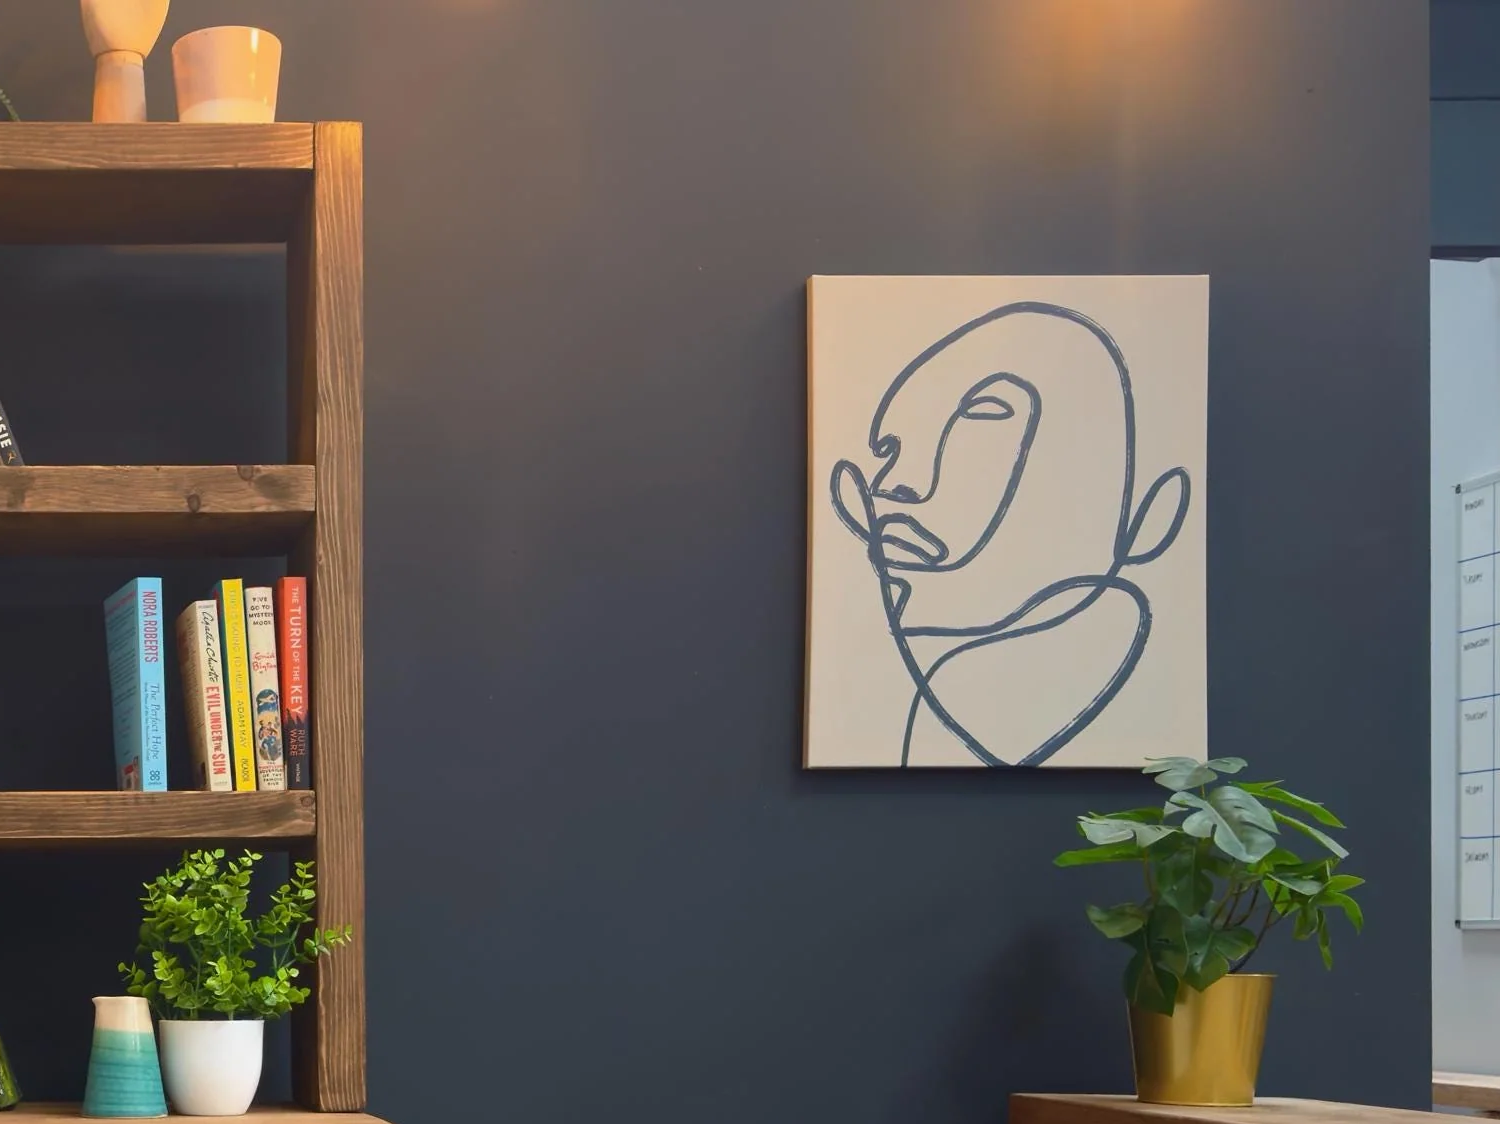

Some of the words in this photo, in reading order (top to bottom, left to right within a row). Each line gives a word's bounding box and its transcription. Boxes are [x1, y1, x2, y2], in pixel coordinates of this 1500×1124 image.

[142, 591, 158, 618] NORA
[291, 586, 300, 604] THE
[289, 606, 303, 648] TURN
[143, 620, 159, 663] ROBERTS
[292, 651, 301, 662] OF
[292, 666, 301, 681] THE
[150, 683, 160, 701] The
[205, 686, 221, 711] EVIL
[290, 685, 304, 714] KEY
[150, 703, 161, 732] Perfect
[210, 711, 223, 741] UNDER
[150, 735, 162, 760] Hope
[213, 741, 222, 752] THE
[238, 729, 248, 748] KAY
[290, 728, 299, 757] WARE
[298, 728, 306, 756] RUTH
[211, 753, 227, 775] SUN
